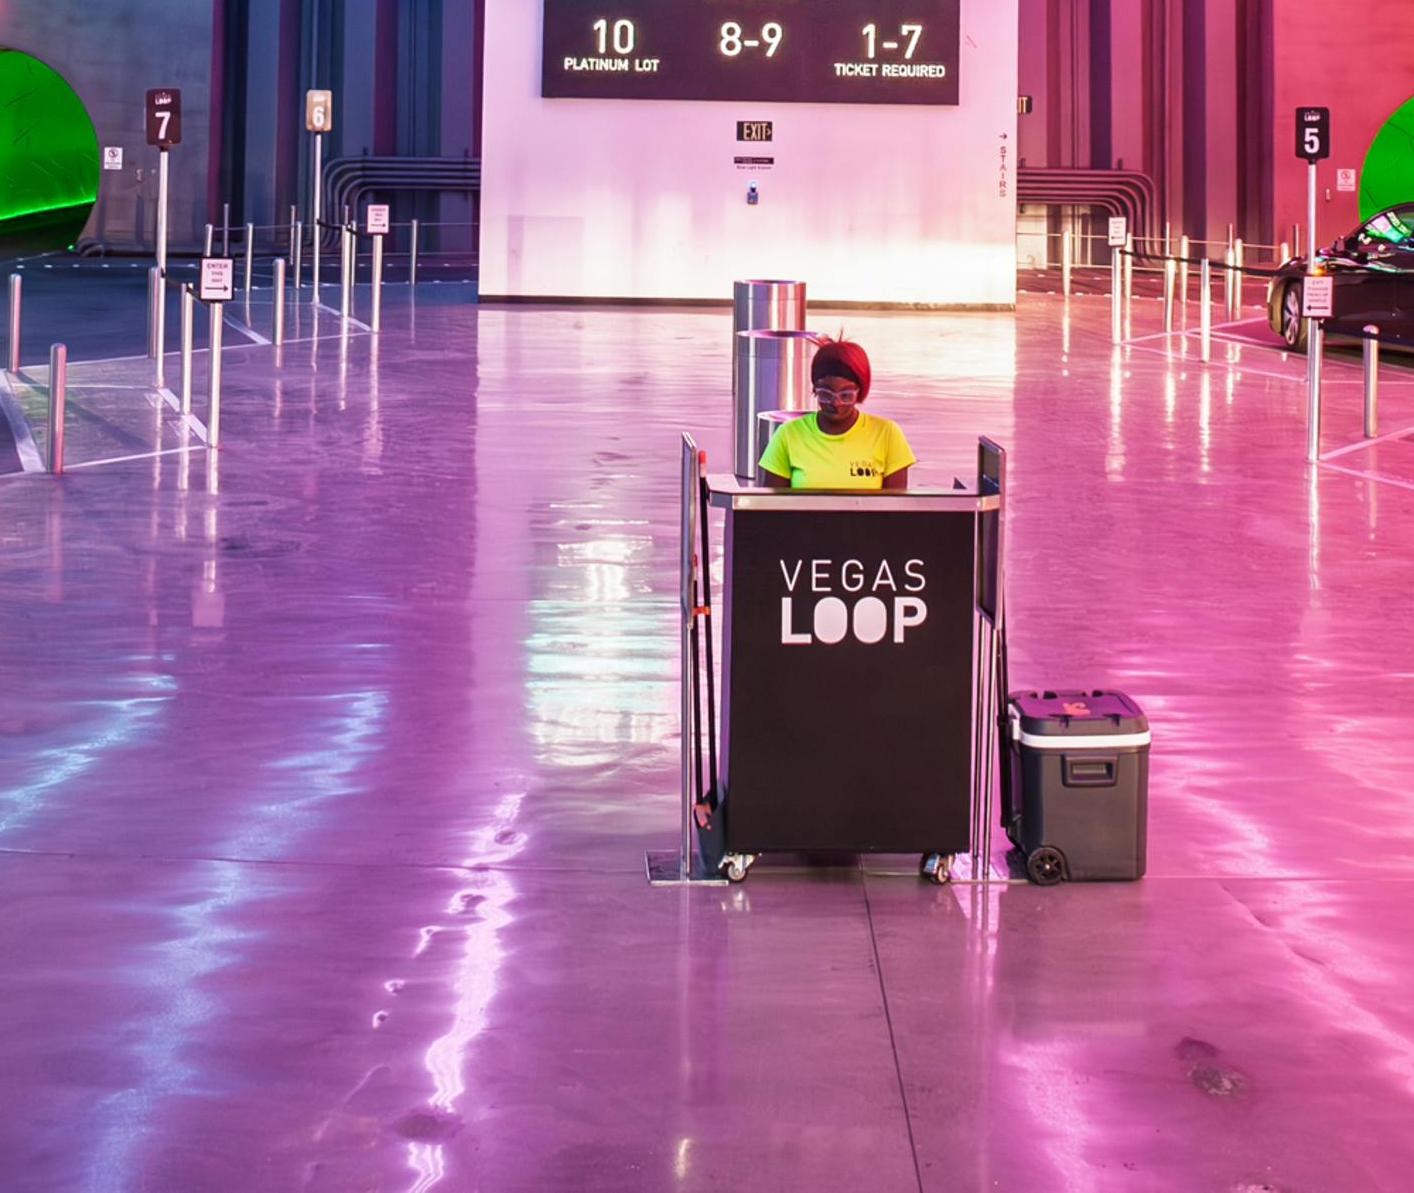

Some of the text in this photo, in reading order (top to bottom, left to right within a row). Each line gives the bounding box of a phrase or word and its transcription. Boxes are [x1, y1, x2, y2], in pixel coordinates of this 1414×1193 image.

[593, 19, 635, 54] 10
[719, 22, 783, 57] 8-9
[861, 23, 923, 59] 1-7
[563, 57, 659, 72] PLATINUM LOT
[834, 62, 946, 78] TICKET REQUIRED
[155, 111, 171, 140] 7
[313, 106, 325, 127] 6
[743, 123, 767, 140] EXIT
[1304, 127, 1320, 154] 5
[780, 559, 926, 592] VEGAS
[781, 596, 928, 644] LOOP
